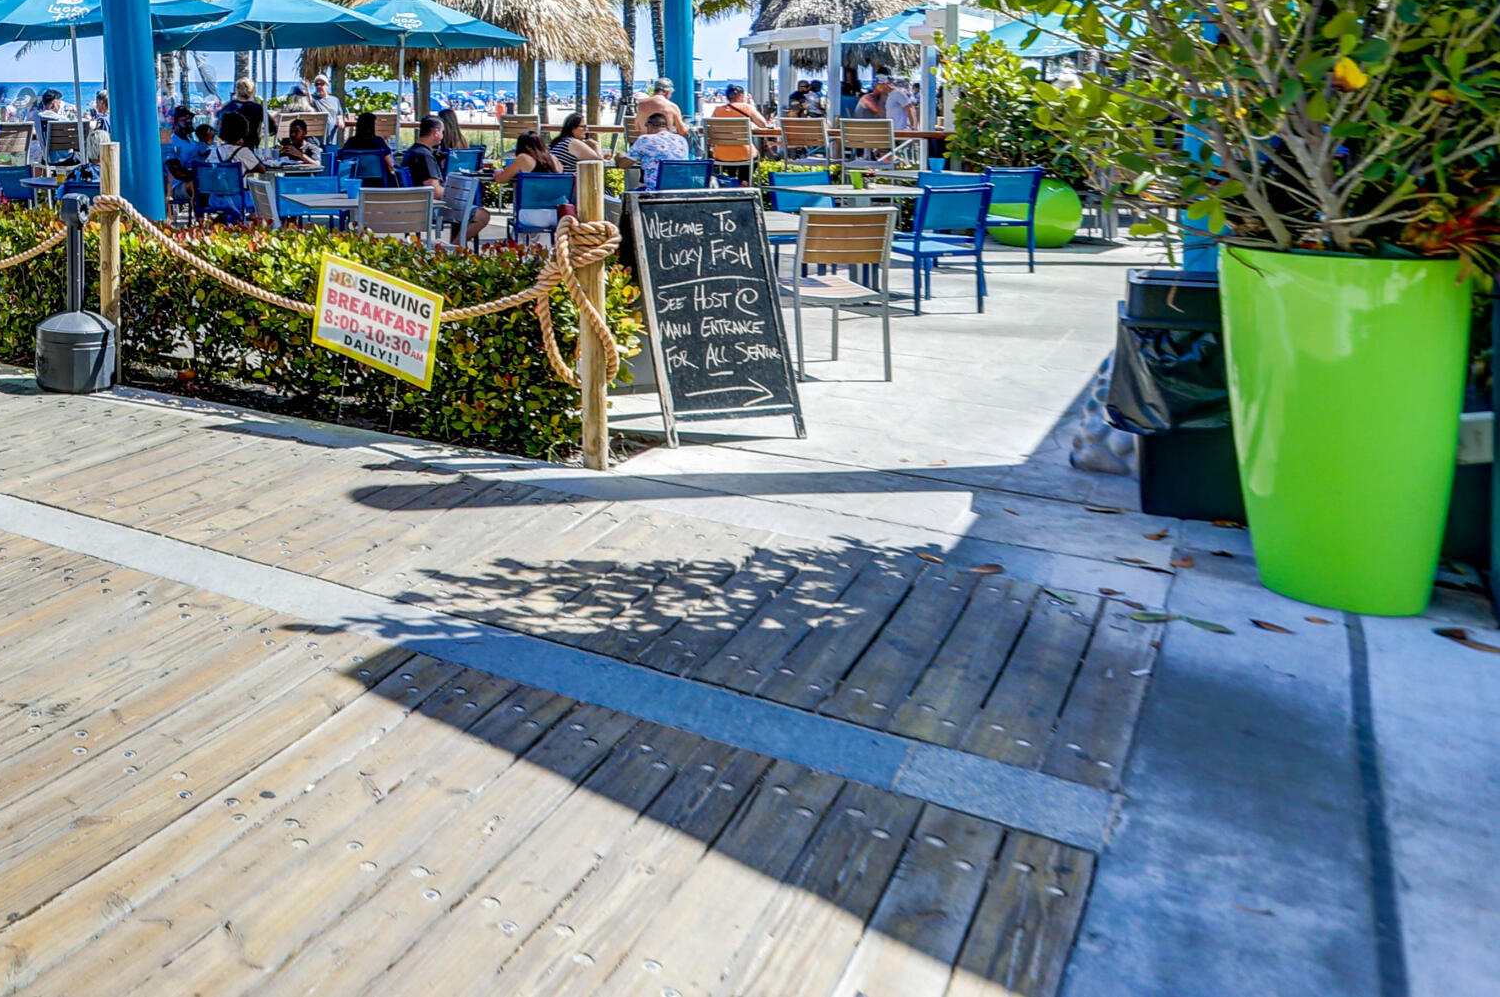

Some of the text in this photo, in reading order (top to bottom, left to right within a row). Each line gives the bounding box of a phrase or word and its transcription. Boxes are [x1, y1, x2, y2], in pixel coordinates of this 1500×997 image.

[326, 288, 429, 342] BREAKFAST
[358, 278, 431, 320] SERVING
[344, 335, 400, 366] DAILY!!
